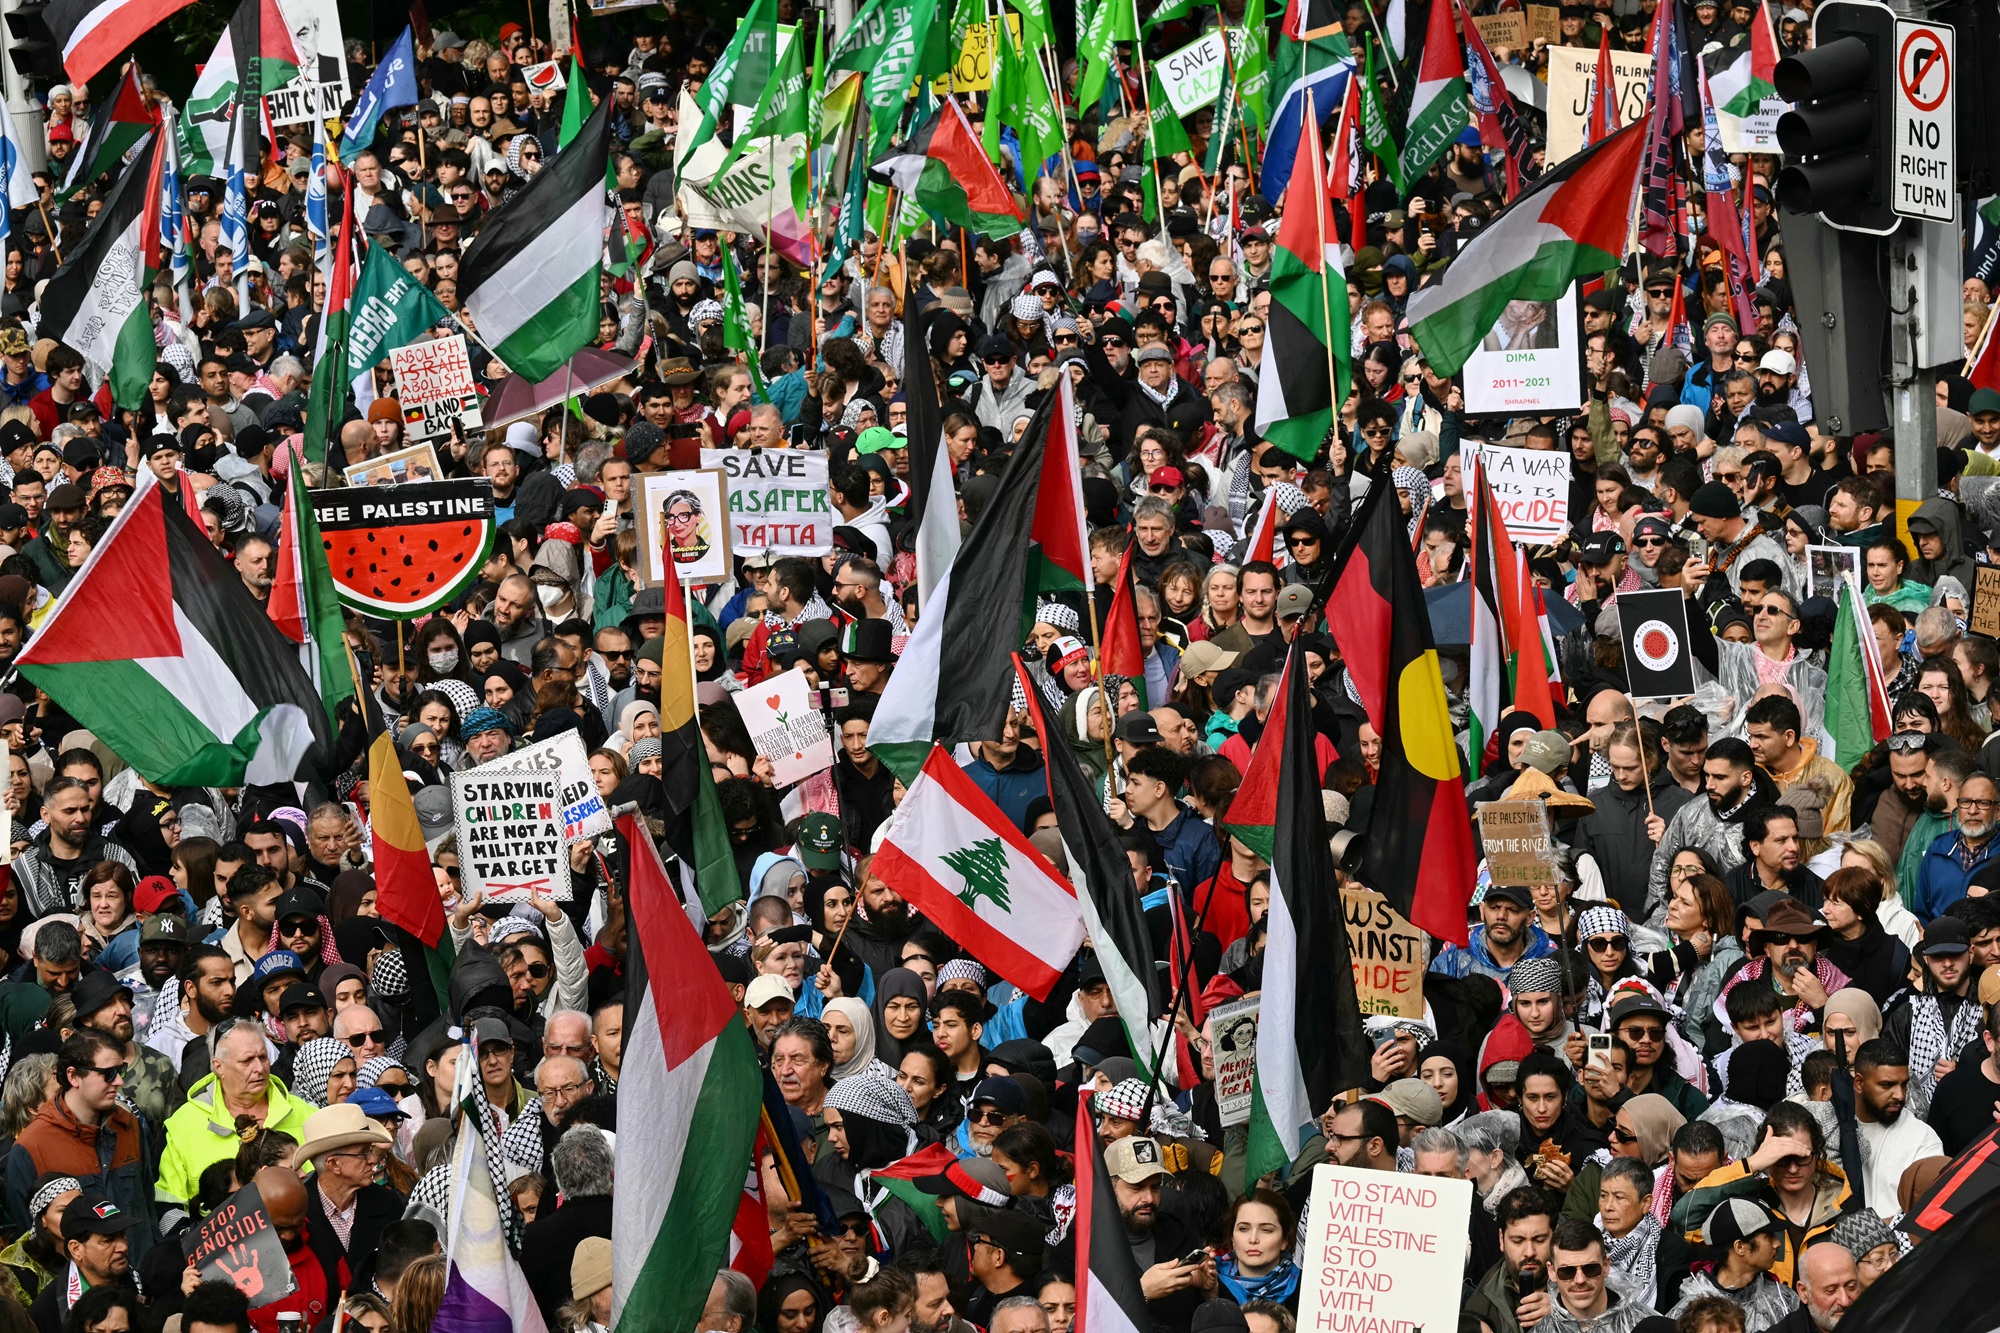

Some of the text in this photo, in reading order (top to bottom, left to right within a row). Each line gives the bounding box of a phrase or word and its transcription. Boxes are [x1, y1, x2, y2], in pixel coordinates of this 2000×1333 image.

[1480, 20, 1519, 31] AUSTRALIA
[1169, 41, 1218, 81] SAVE
[1575, 62, 1650, 79] AUSALIAN
[267, 90, 300, 120] SHIT
[304, 84, 344, 115] CNT
[1909, 118, 1941, 150] NO
[1901, 154, 1947, 180] RIGHT
[1902, 182, 1946, 208] TURN
[395, 340, 460, 365] ABOLISH
[1506, 353, 1536, 363] DIMA
[400, 371, 465, 394] ABOLISH
[1492, 377, 1551, 389] 2011-2021
[424, 397, 460, 419] LAND
[722, 454, 806, 478] SAVE
[1500, 454, 1515, 473] A
[1523, 456, 1567, 481] WAR
[729, 488, 831, 512] ASAFER
[1490, 483, 1556, 498] HIS IS
[314, 498, 485, 523] REE PALESTINE
[736, 523, 816, 547] YATTA
[1975, 606, 1989, 614] IN
[1973, 616, 1996, 630] THE
[1059, 649, 1086, 666] PALESTI
[752, 709, 822, 747] PALESTINE LEBANON
[756, 720, 826, 755] LEBANON PALESTINE
[765, 729, 830, 764] ALESTINE LEBANON
[464, 781, 554, 802] STARVING
[465, 802, 553, 824] CHILDREN
[563, 796, 603, 825] ISRAEL
[1482, 810, 1540, 825] REE PALESTINE
[469, 823, 558, 843] ARE NOT A
[471, 840, 558, 859] MILITARY
[1483, 837, 1549, 854] FROM THE RIVER
[474, 858, 558, 878] TARGET
[1496, 866, 1551, 881] TO THE SEA
[1343, 894, 1394, 930] WS
[1345, 930, 1419, 964] AINST
[259, 953, 294, 975] THUNDER
[1352, 964, 1411, 994] CIDE
[1220, 1057, 1255, 1074] MEANS
[1221, 1067, 1255, 1086] NEVER
[1222, 1085, 1240, 1097] FOR
[1331, 1179, 1437, 1208] TO STAND
[200, 1204, 237, 1240] STOP
[1329, 1201, 1384, 1225] WITH
[187, 1210, 268, 1266] GENOCIDE
[1326, 1223, 1437, 1253] PALESTINE
[1323, 1245, 1377, 1268] IS TO
[1320, 1267, 1393, 1292] STAND
[1319, 1289, 1374, 1313] WITH
